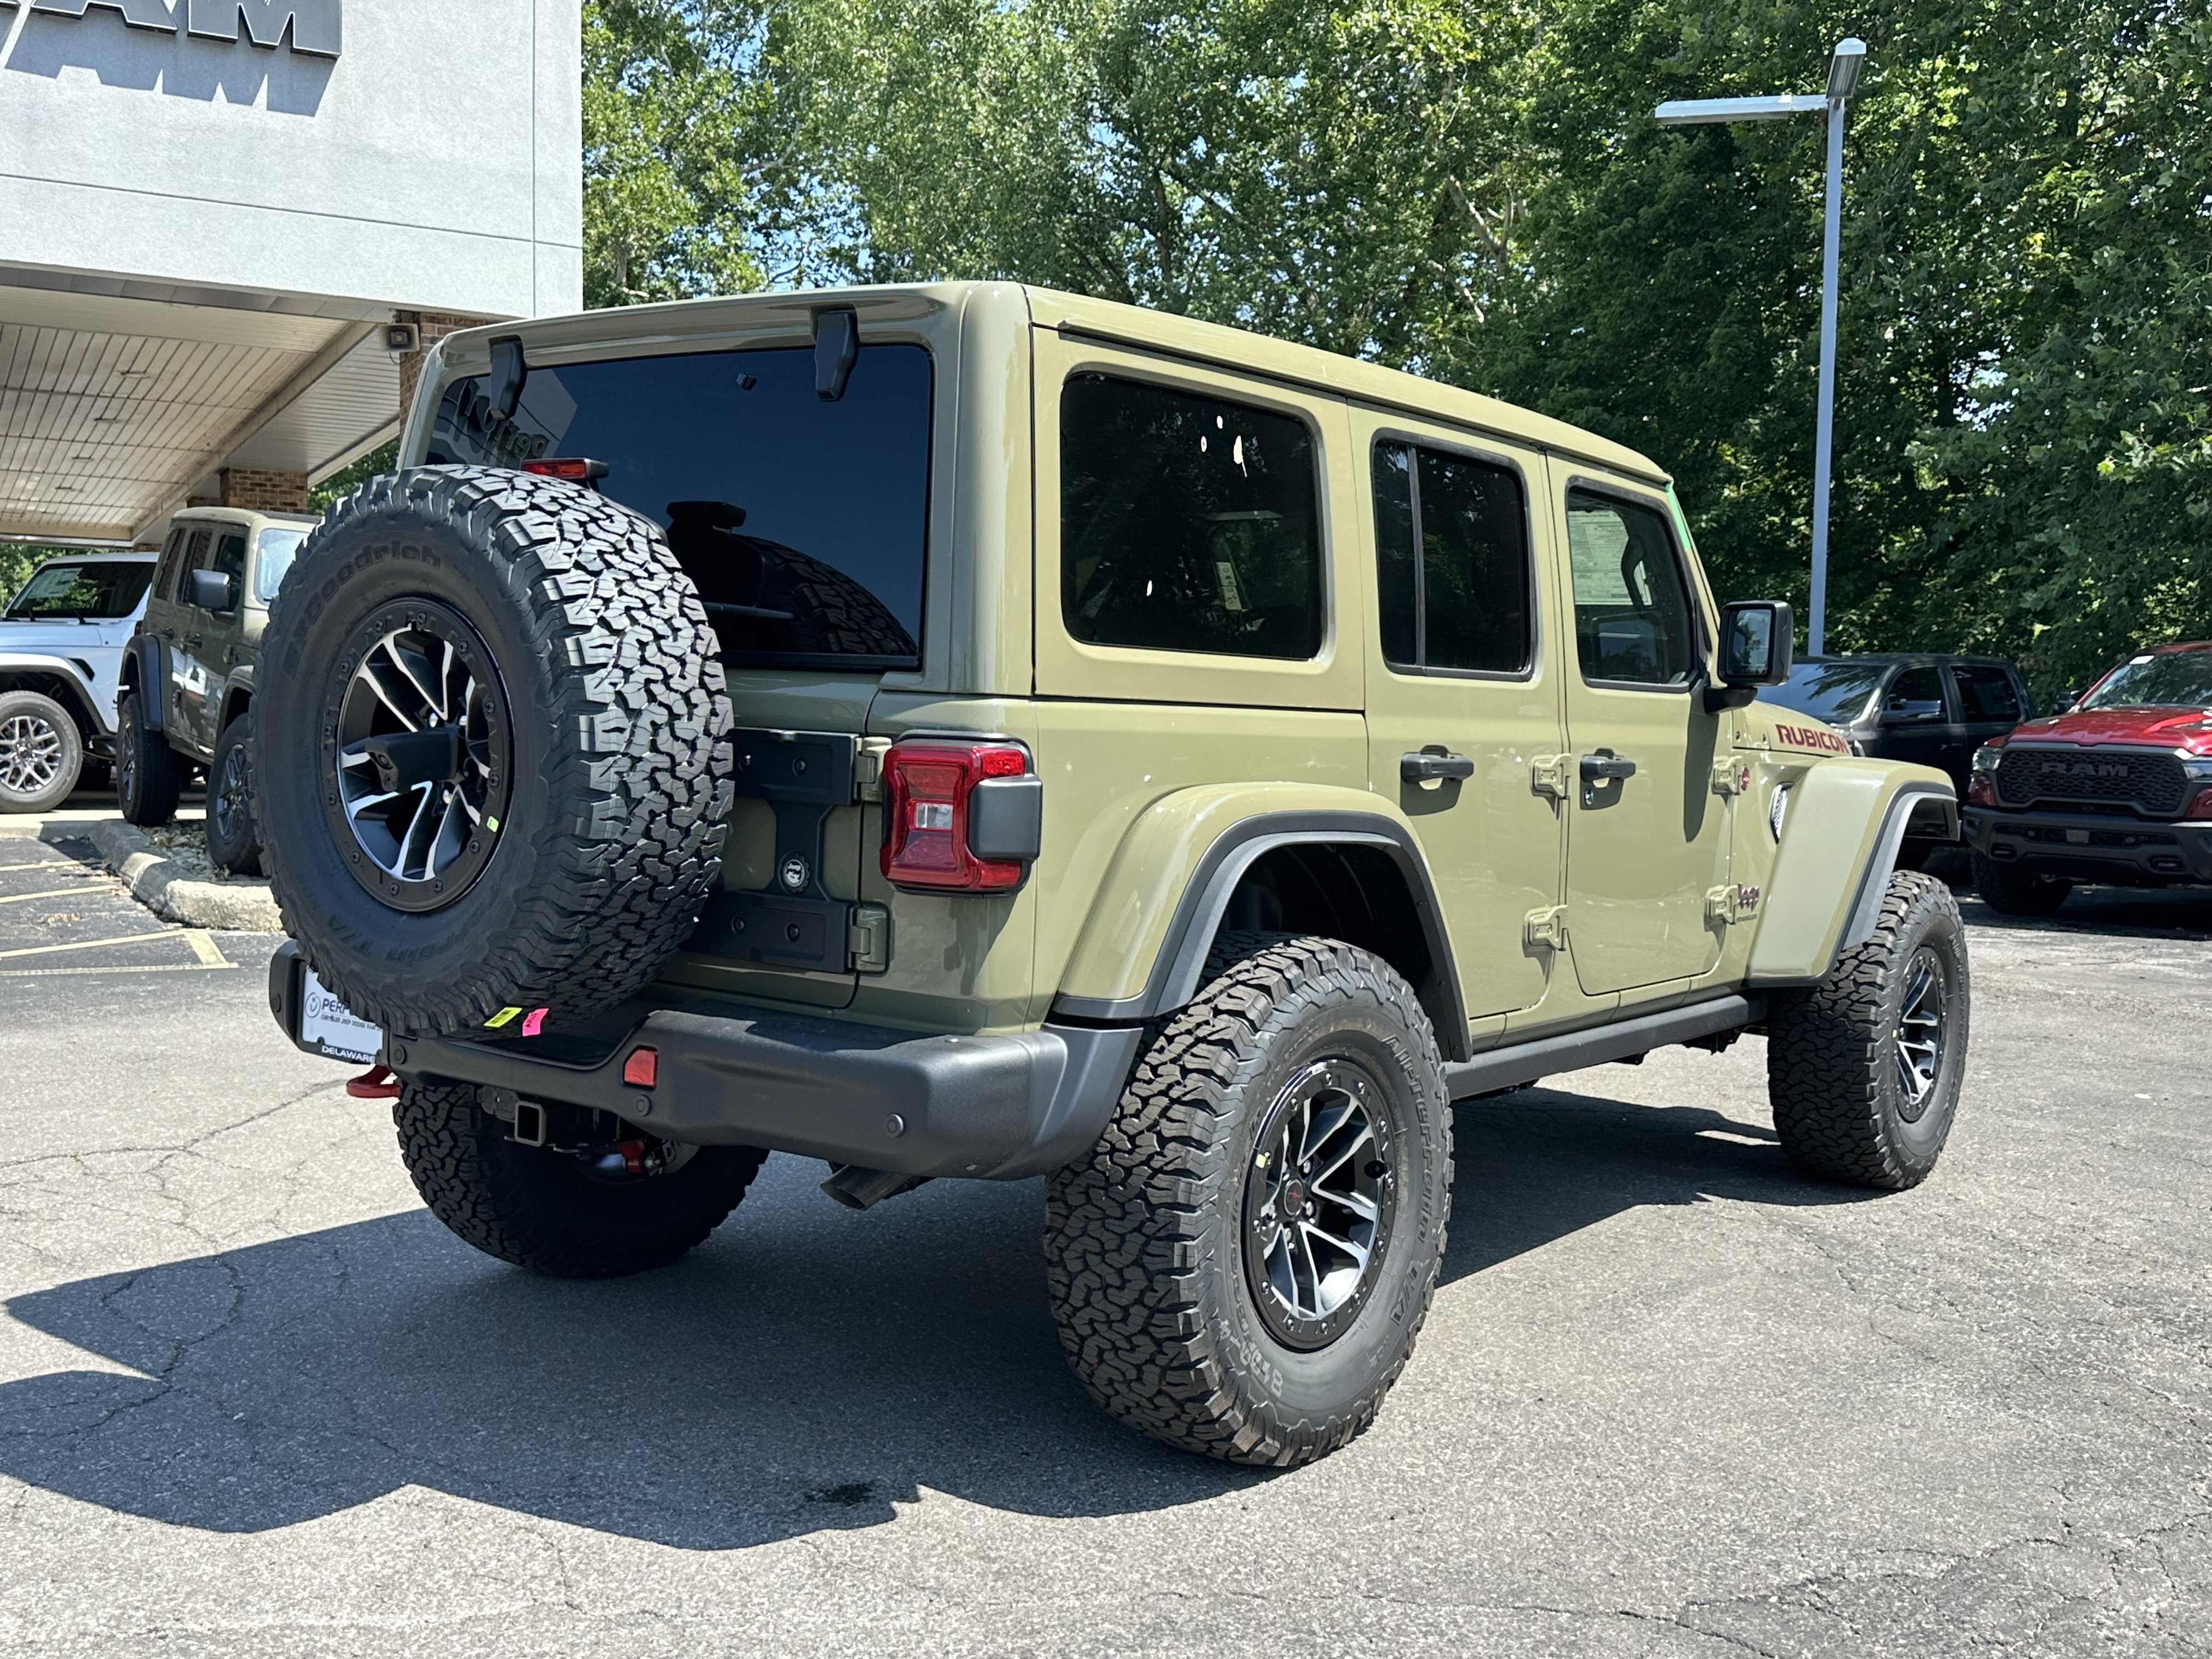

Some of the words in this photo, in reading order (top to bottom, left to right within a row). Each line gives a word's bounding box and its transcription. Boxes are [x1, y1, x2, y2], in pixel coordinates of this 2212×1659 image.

[1775, 724, 1849, 753] RUBICON
[2041, 761, 2129, 777] RAM
[321, 1045, 376, 1063] DELAWARE
